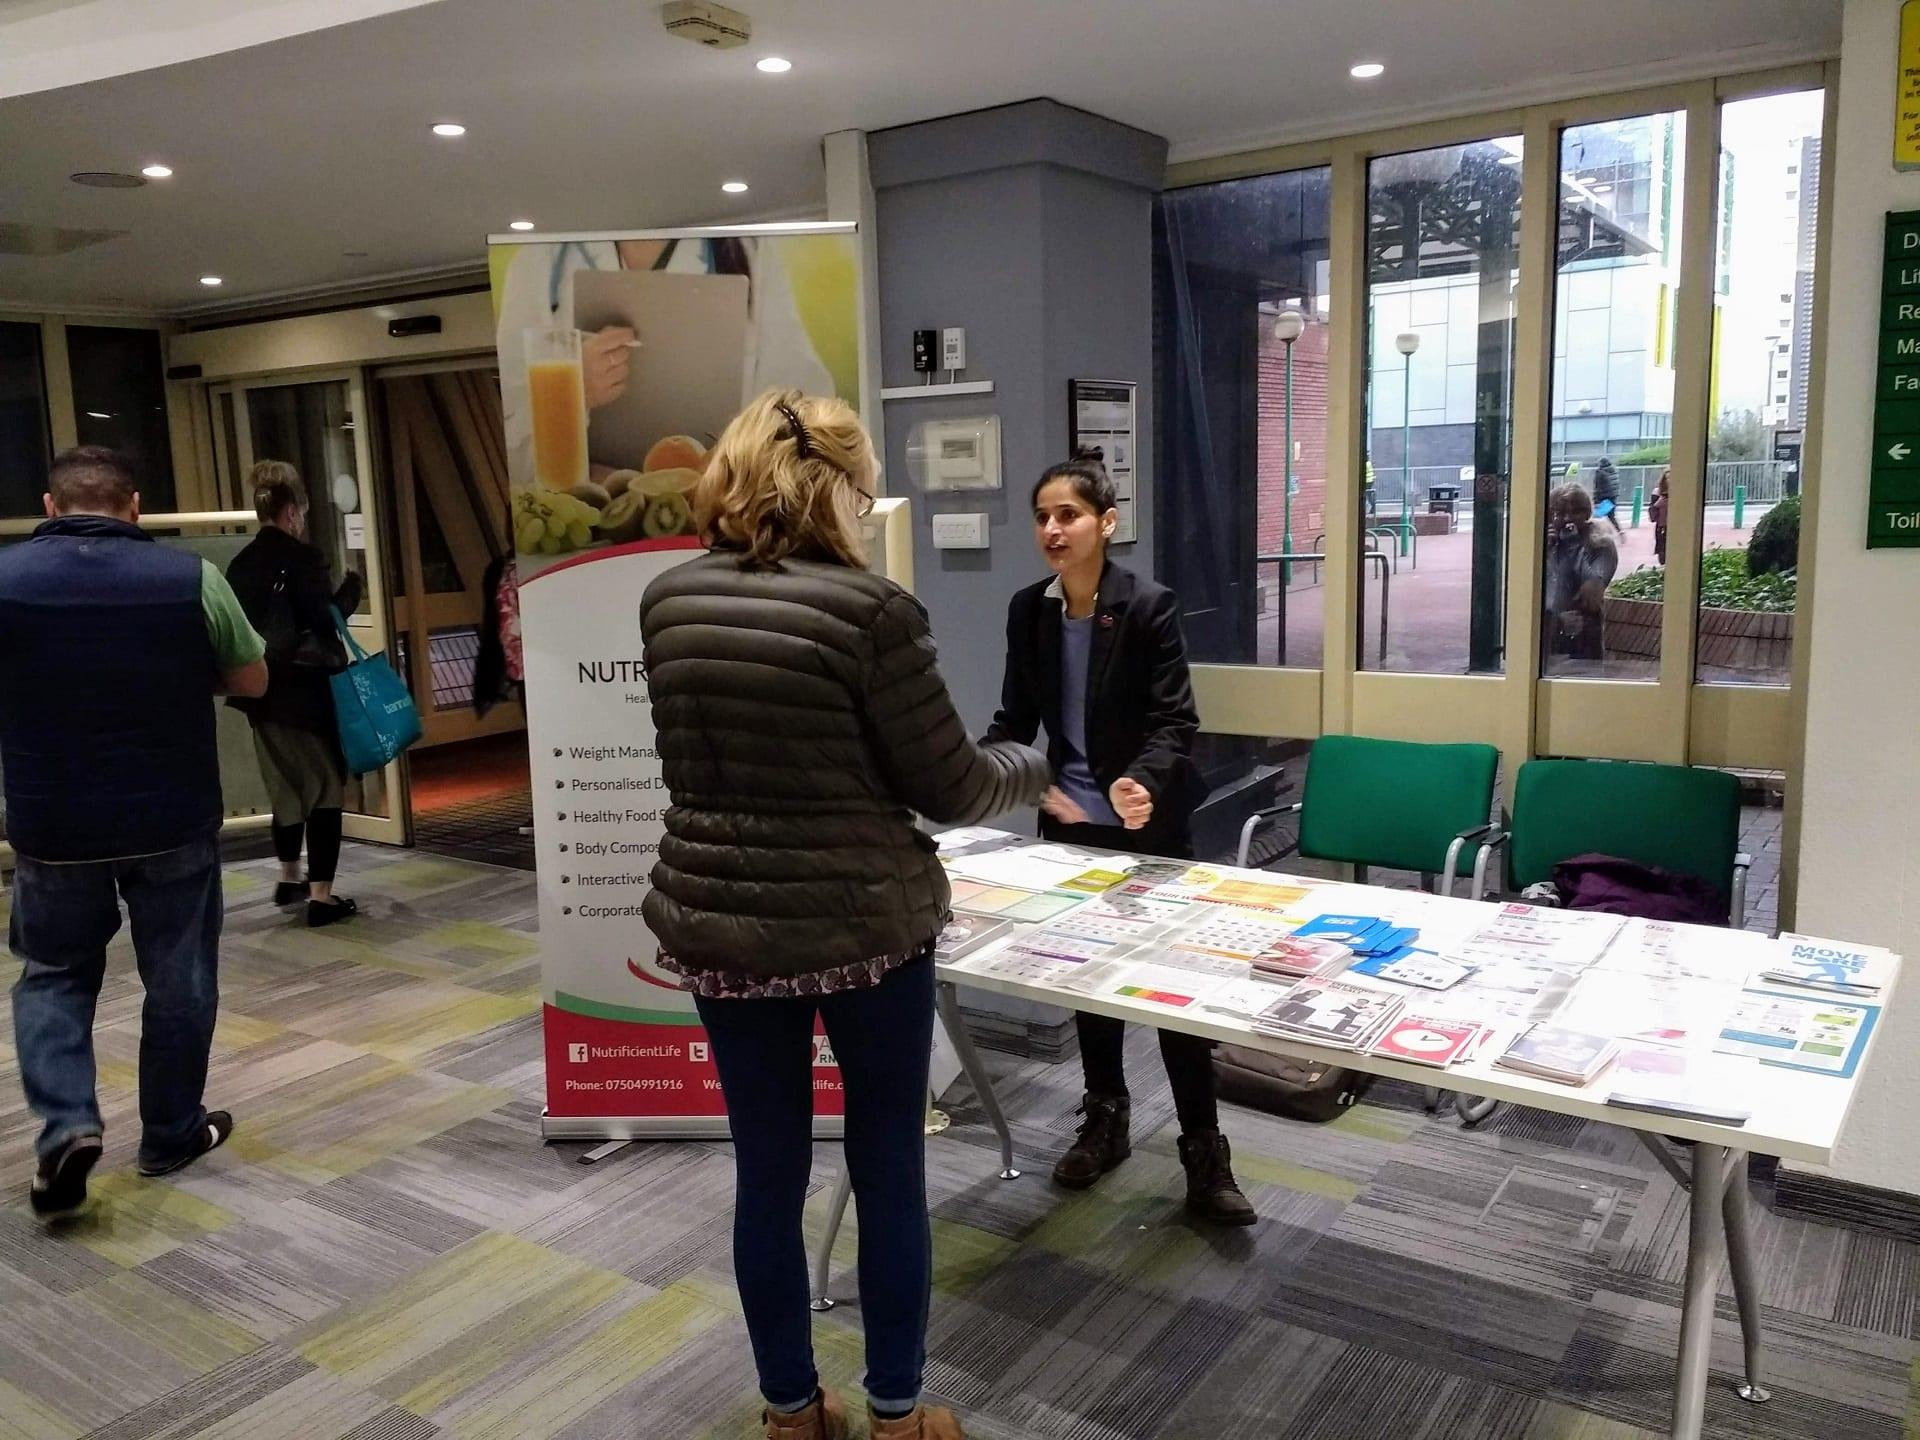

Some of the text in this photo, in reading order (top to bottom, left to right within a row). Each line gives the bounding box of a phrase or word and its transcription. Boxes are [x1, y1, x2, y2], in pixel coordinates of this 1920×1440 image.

[1903, 232, 1920, 248] D
[1886, 512, 1920, 528] Toil
[579, 661, 648, 683] NUTR
[569, 746, 616, 761] Weight
[572, 777, 666, 791] Personalised D
[574, 810, 623, 824] Healthy
[625, 809, 656, 821] Food
[576, 842, 607, 856] Body
[578, 873, 644, 886] Interactive
[579, 905, 643, 918] Corporate
[1793, 944, 1869, 960] MOVE
[591, 1045, 681, 1058] NutrificientLife
[565, 1080, 604, 1090] Phone:
[605, 1079, 684, 1090] 07504991916
